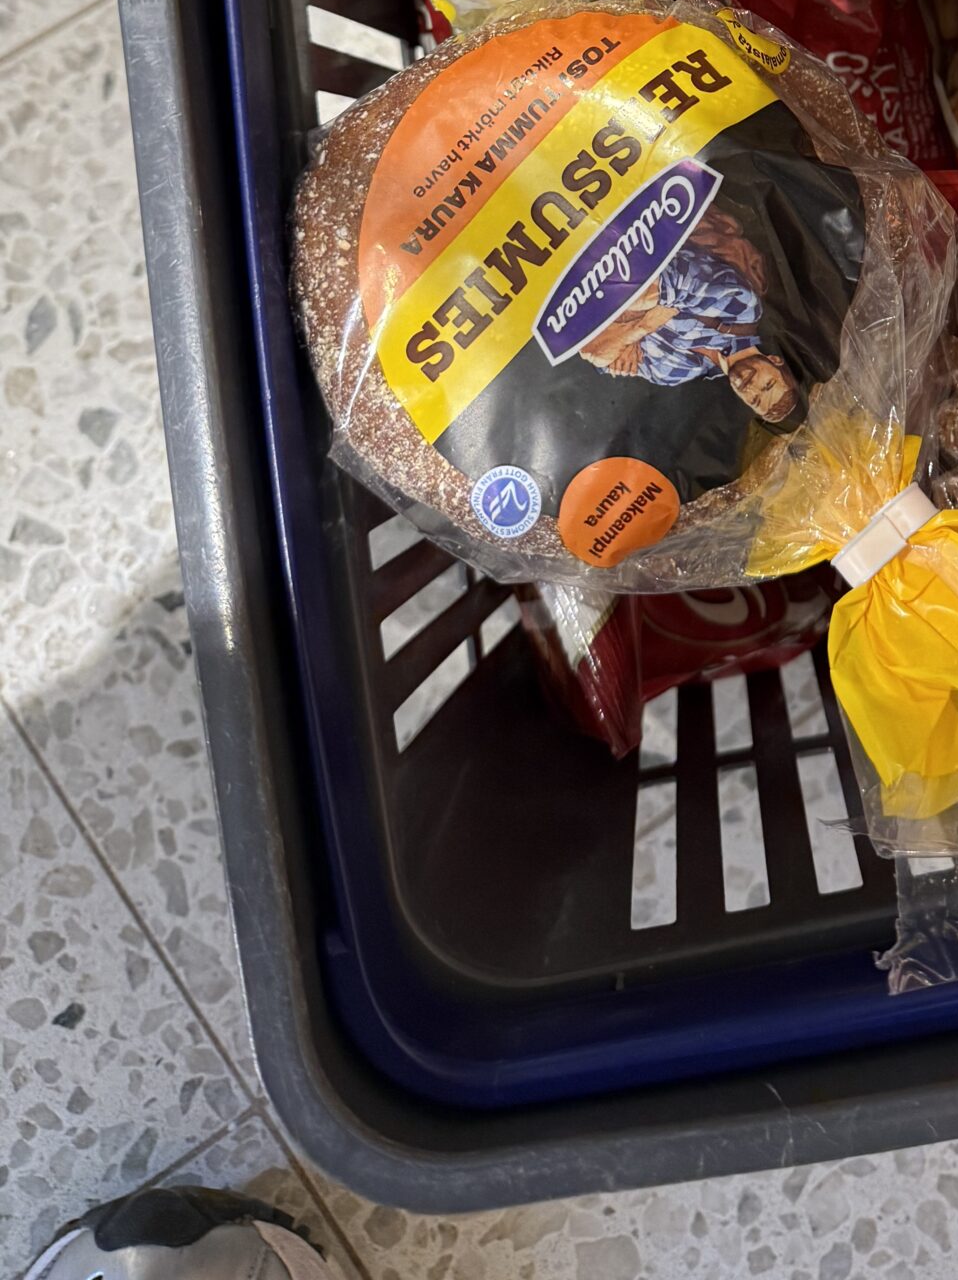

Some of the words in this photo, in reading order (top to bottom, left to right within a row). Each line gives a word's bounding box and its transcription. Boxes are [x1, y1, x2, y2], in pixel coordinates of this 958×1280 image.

[560, 36, 622, 88] TOSI
[456, 94, 513, 152] mörkt
[474, 86, 562, 174] TUMMA
[413, 148, 463, 200] havre
[399, 170, 483, 256] KAURA
[547, 174, 696, 334] Oululainen
[583, 480, 632, 529] kaura
[587, 481, 662, 560] Makeampi
